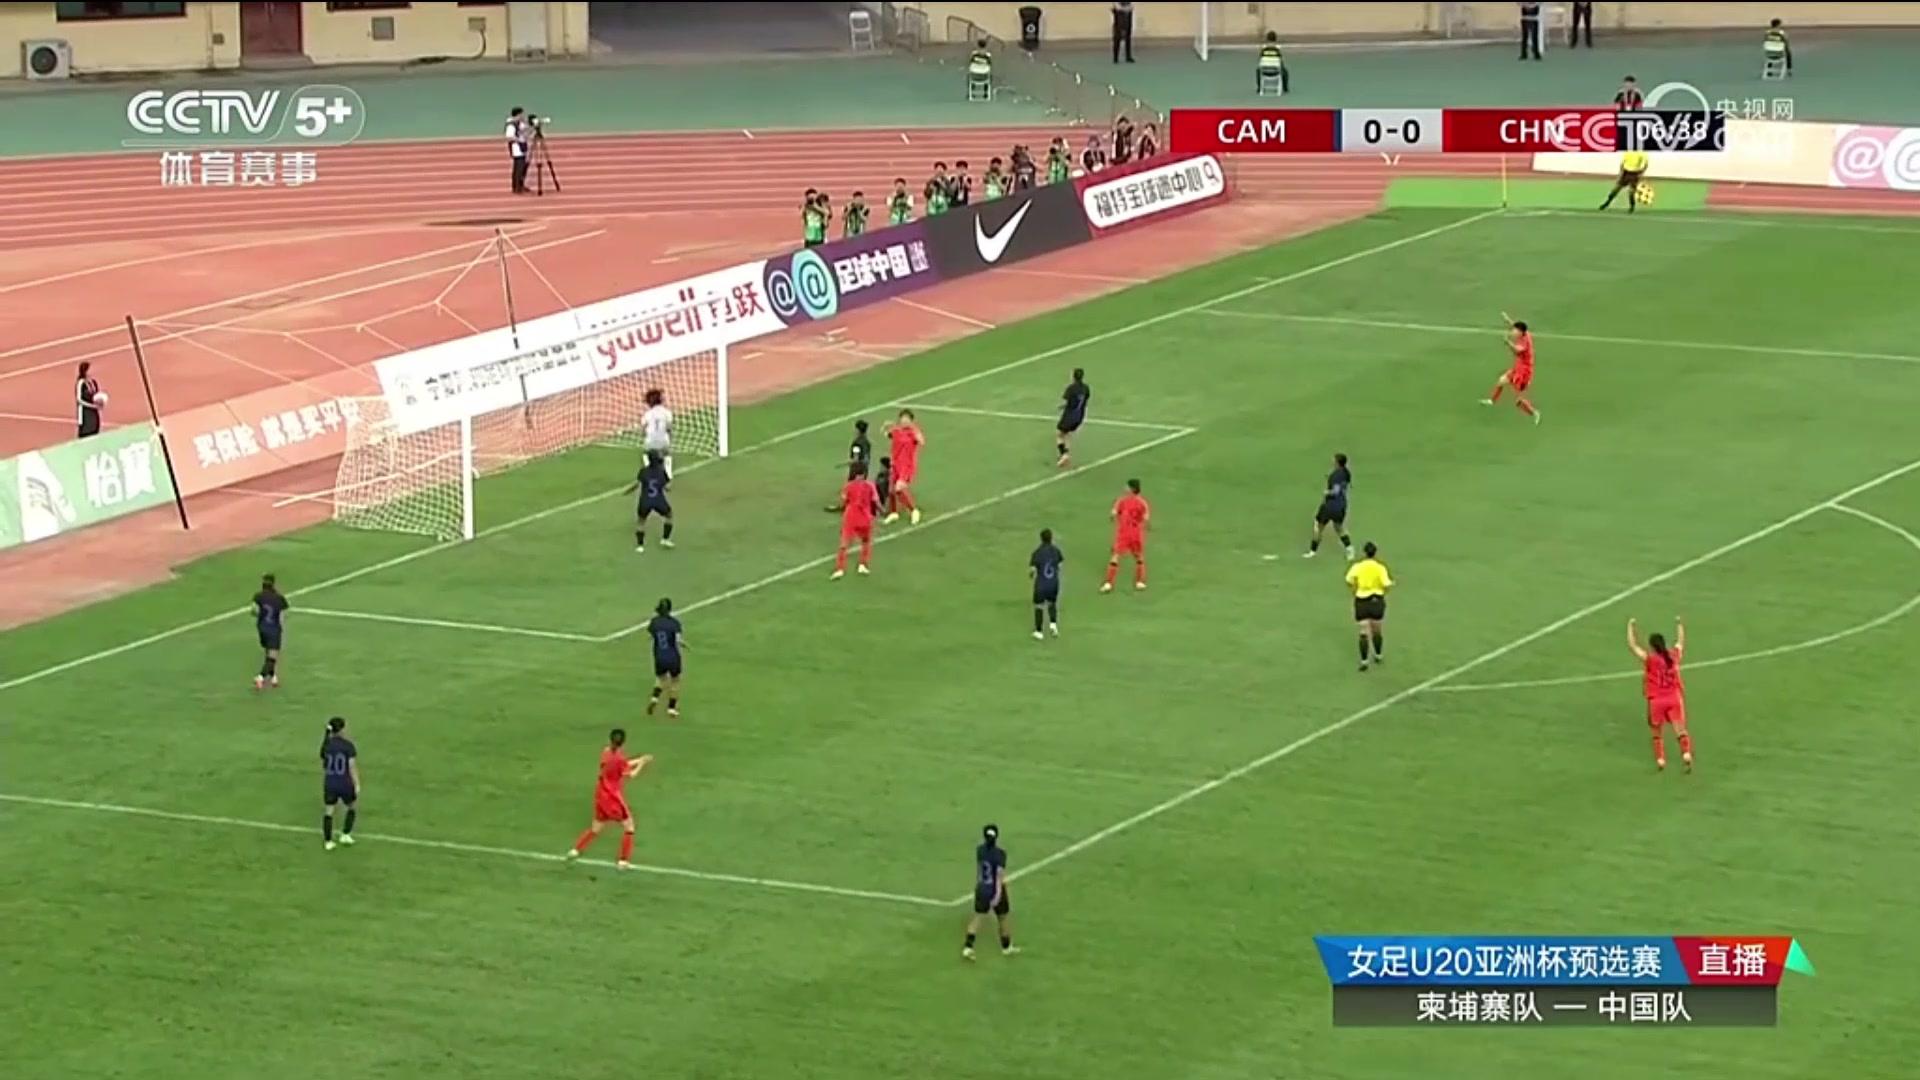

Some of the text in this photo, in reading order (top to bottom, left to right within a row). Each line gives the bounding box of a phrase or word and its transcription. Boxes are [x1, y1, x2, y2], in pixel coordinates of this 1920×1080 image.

[833, 243, 912, 295] 足球中国
[193, 423, 261, 468] 买保险
[647, 479, 658, 498] 5
[1043, 558, 1056, 580] 6
[262, 602, 275, 625] 2
[324, 752, 346, 776] 20
